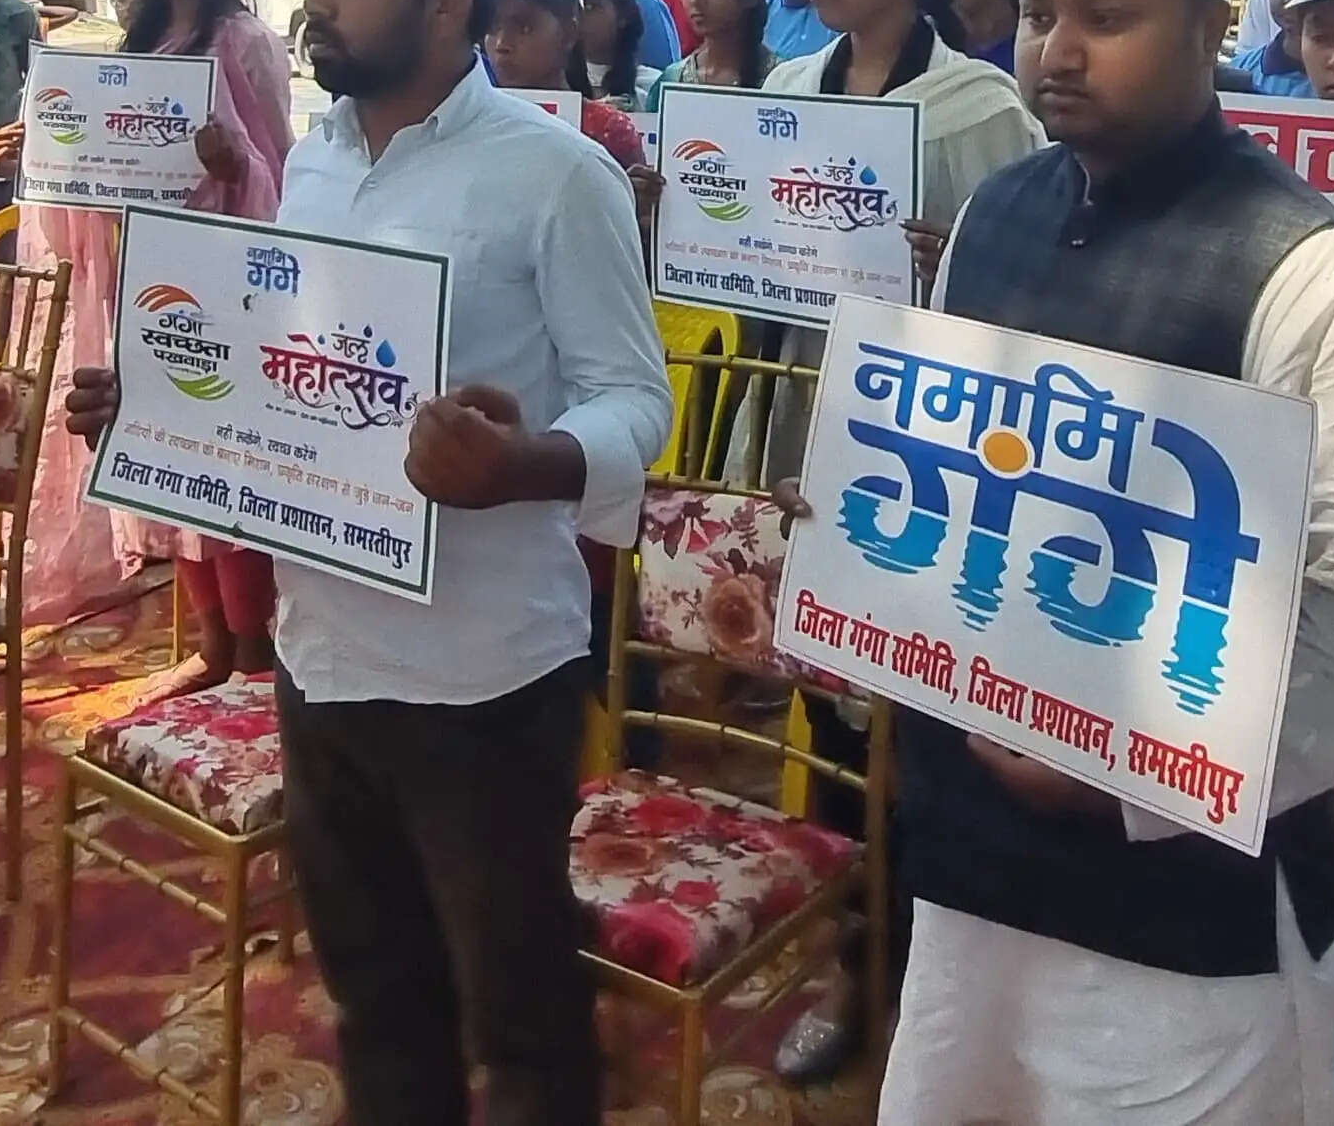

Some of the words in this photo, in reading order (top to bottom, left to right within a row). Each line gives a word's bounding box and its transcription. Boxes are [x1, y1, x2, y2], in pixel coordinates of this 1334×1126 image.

[104, 104, 190, 147] महोत्सव
[678, 172, 746, 191] स्वच्छता
[769, 167, 889, 232] महोत्सव
[762, 278, 792, 301] जिला
[141, 328, 231, 361] स्वच्छता
[158, 310, 207, 336] गंगा
[154, 349, 217, 373] पखवाड़ा
[260, 332, 410, 430] महोत्सव
[854, 342, 1145, 493] नमामि
[111, 452, 153, 485] जिला
[155, 464, 184, 494] गंगा
[186, 474, 232, 513] समिति,
[238, 486, 278, 522] जिला
[281, 503, 338, 545] प्रशासन,
[343, 522, 413, 569] समस्तीपुर
[794, 589, 848, 648] जिला
[849, 612, 890, 666] गंगा
[892, 632, 959, 704] समिति,
[967, 655, 1029, 723] जिला
[1030, 689, 1117, 771] प्रशासन,
[1128, 727, 1245, 824] समस्तीपुर
